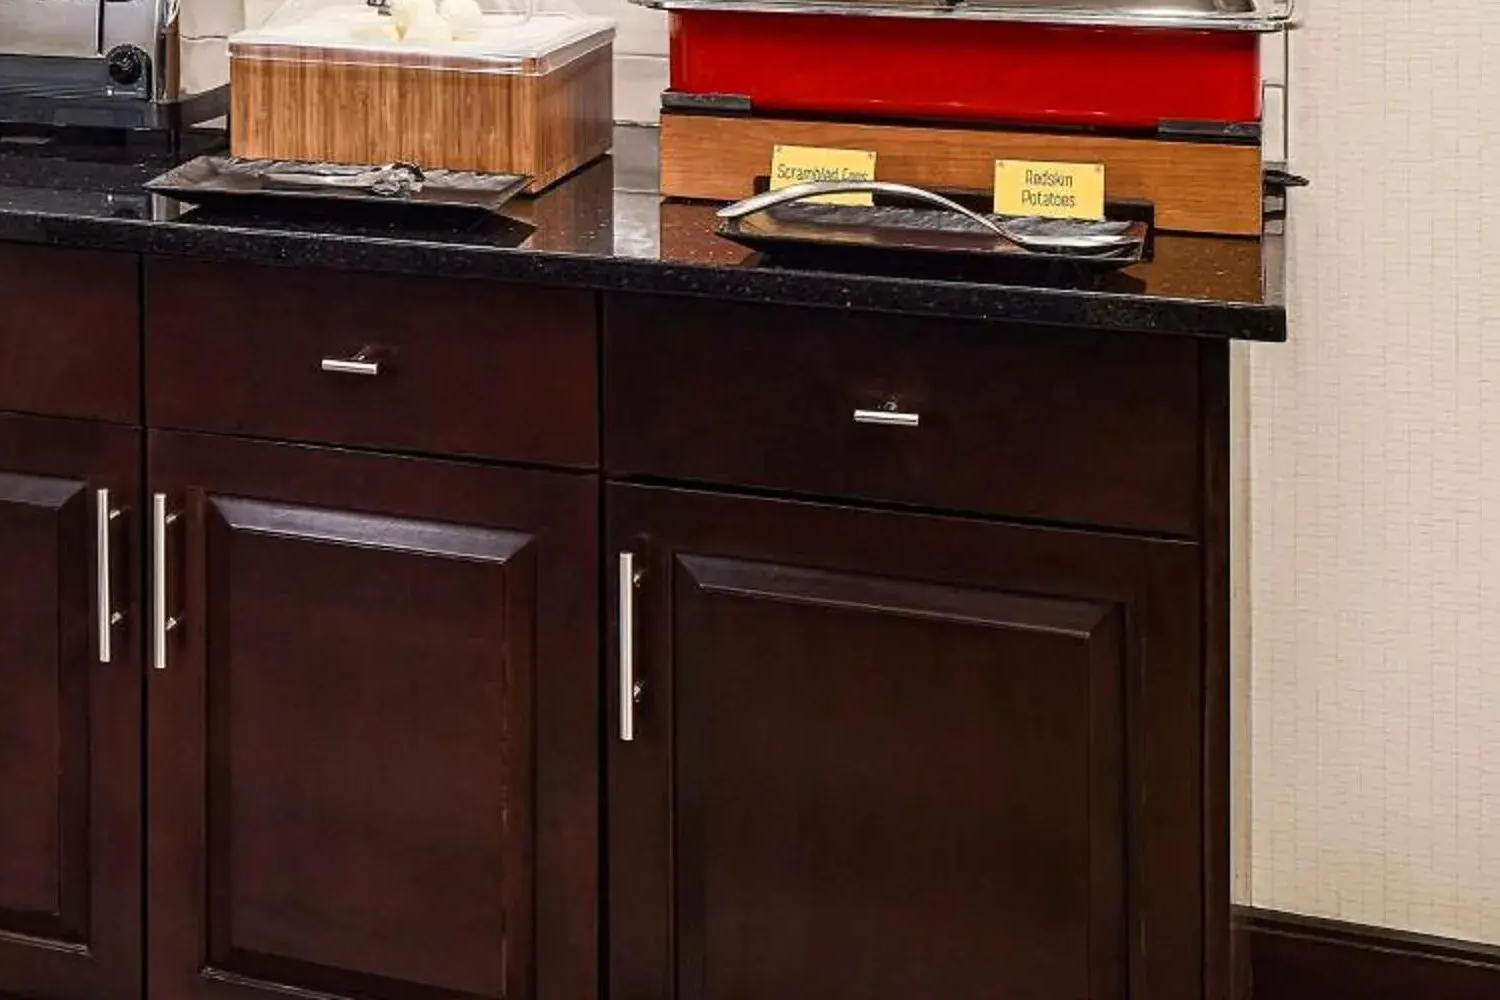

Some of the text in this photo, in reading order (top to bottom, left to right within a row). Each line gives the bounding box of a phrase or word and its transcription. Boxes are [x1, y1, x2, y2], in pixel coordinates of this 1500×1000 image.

[776, 164, 839, 182] Scrambled
[1025, 168, 1073, 188] Redskin
[1021, 189, 1076, 209] Potatoes
